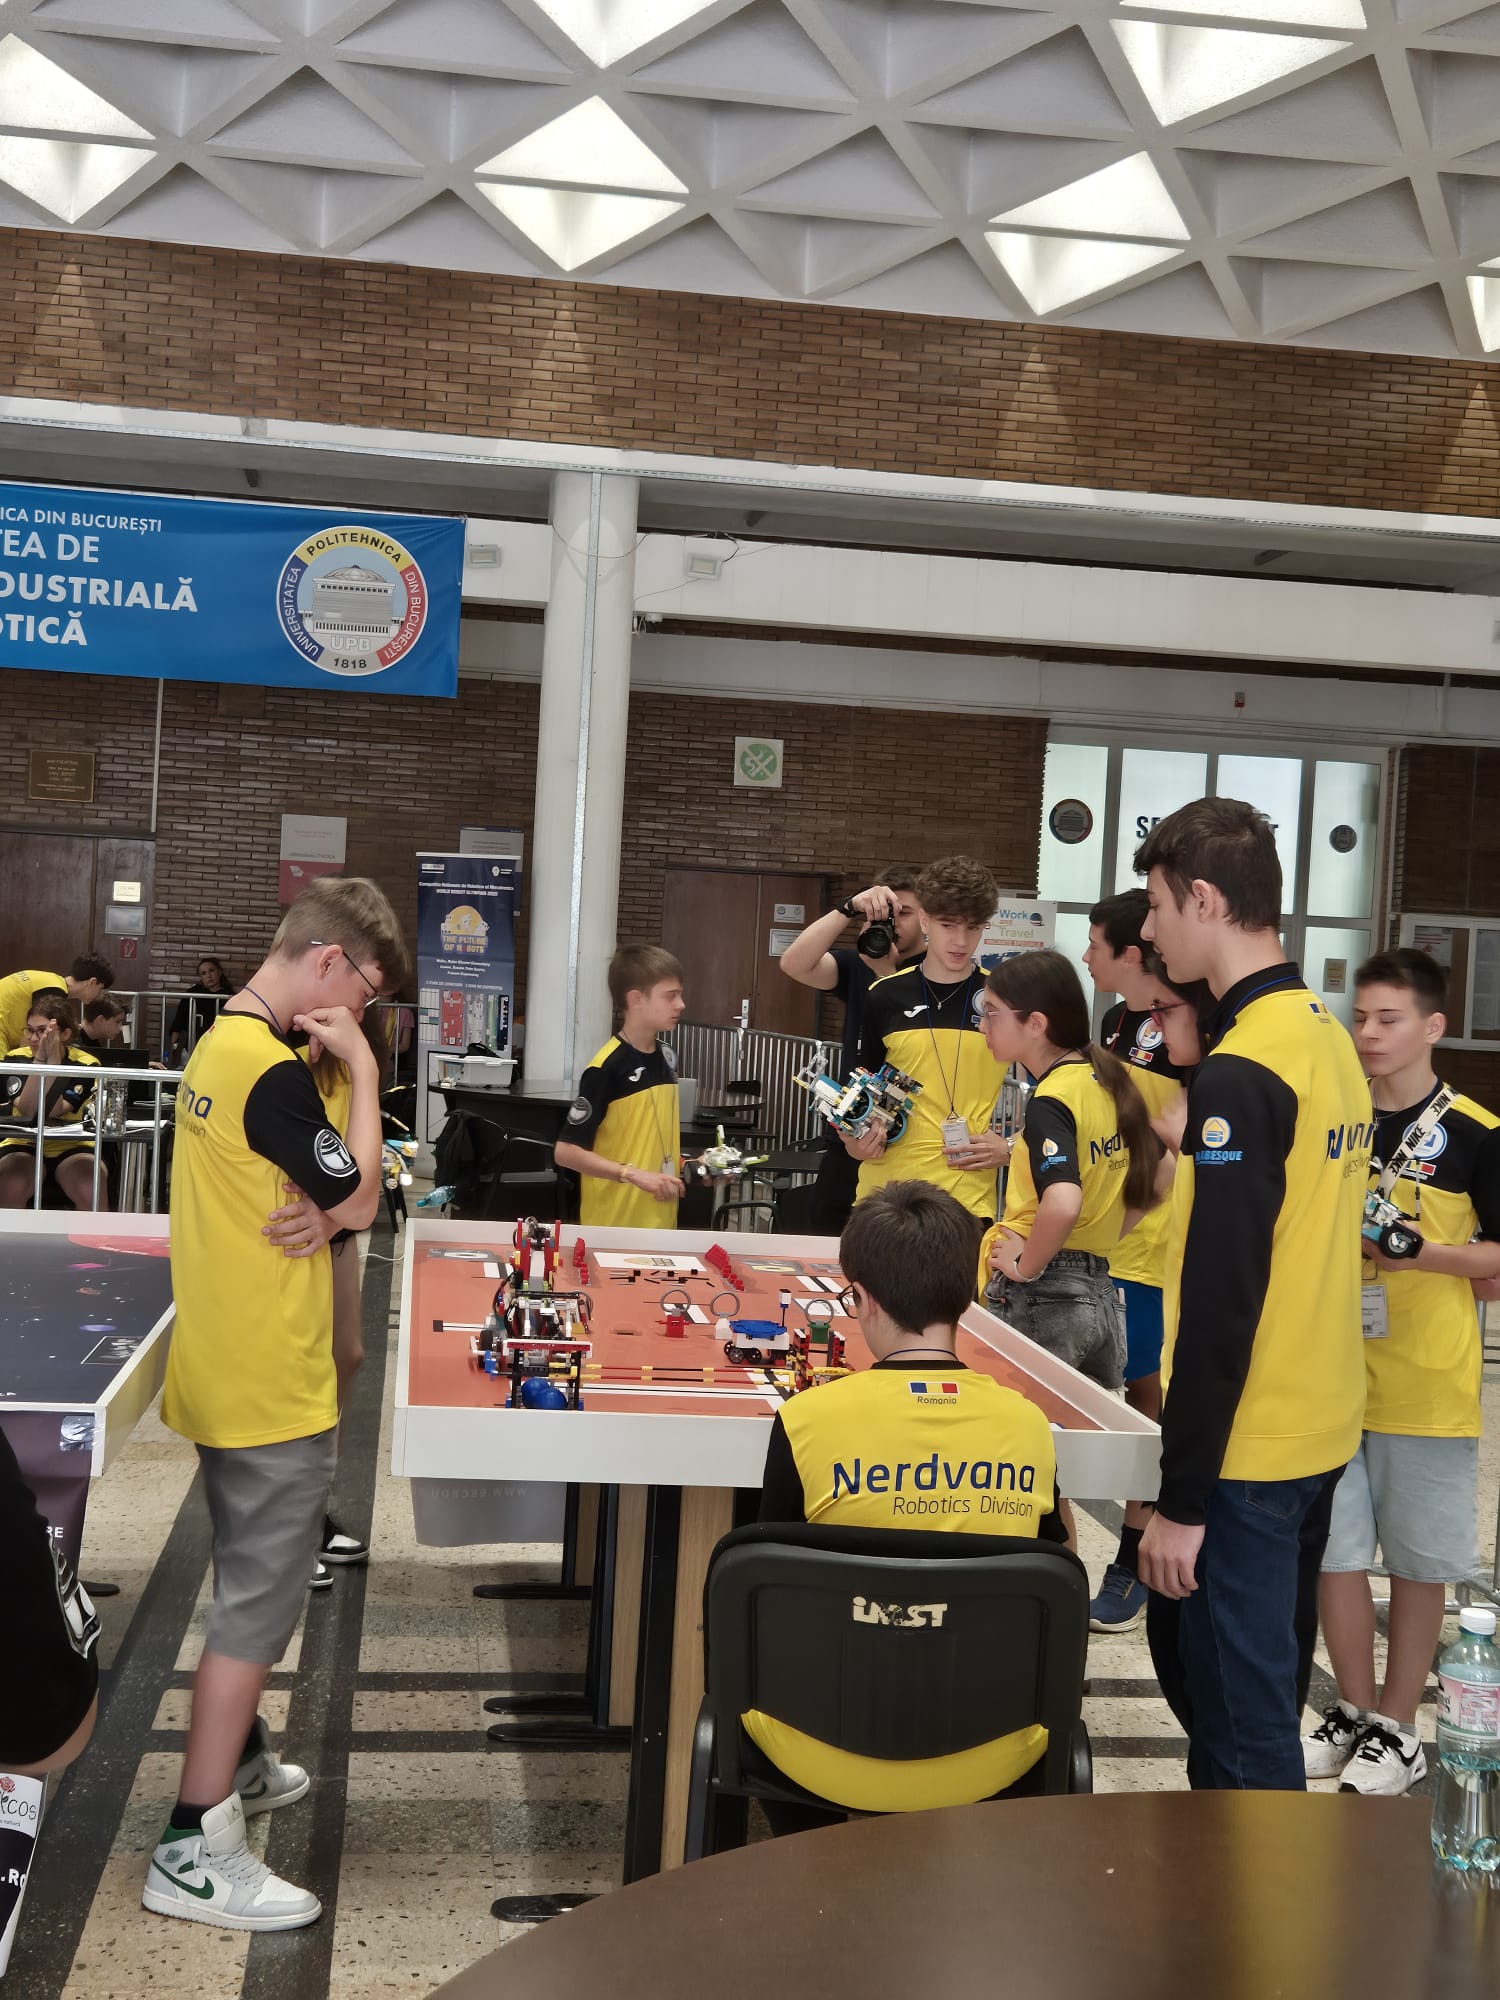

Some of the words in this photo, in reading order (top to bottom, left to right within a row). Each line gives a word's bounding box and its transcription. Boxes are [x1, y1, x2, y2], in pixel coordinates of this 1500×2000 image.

[34, 509, 66, 525] DIN
[71, 512, 162, 535] BUCUREȘTI
[0, 529, 47, 559] EA
[57, 533, 100, 563] DE
[306, 532, 402, 563] POLITEHNICA
[405, 571, 420, 594] DIN
[283, 567, 320, 657] UNIVERSITATEA
[0, 610, 88, 646] TICĂ
[331, 635, 371, 651] UPB
[334, 657, 367, 669] 1818
[1000, 909, 1029, 920] Work
[1000, 926, 1034, 939] Travel
[1430, 1092, 1451, 1116] NIKE
[1405, 1123, 1426, 1151] NIKE
[917, 1395, 957, 1404] Romania
[832, 1453, 1035, 1499] Nerdvana
[893, 1495, 971, 1516] Robotics
[980, 1495, 1033, 1518] Division
